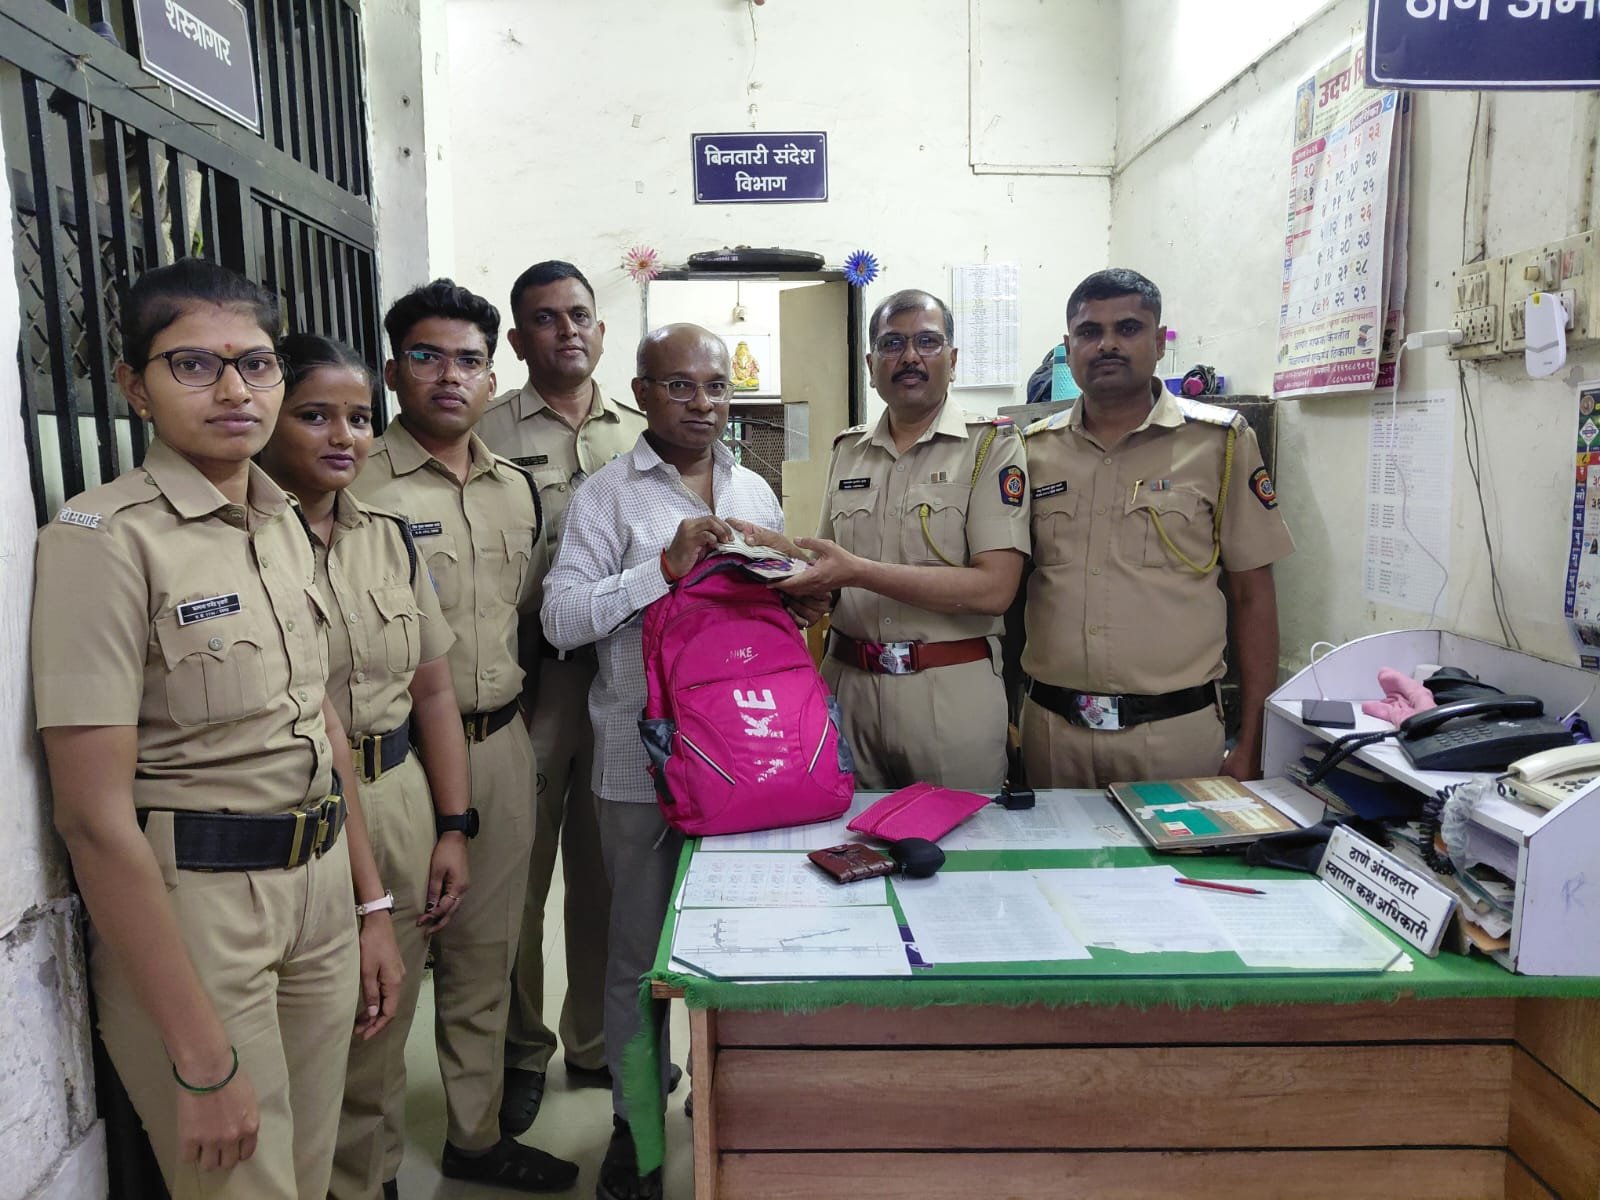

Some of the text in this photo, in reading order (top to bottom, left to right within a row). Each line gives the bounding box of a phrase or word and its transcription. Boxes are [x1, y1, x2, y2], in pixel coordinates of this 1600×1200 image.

[165, 0, 231, 66] शस्त्रागार
[704, 143, 816, 166] बिनतारी संदेश
[735, 171, 787, 192] विभाग
[1349, 846, 1419, 900] ठाणे अंमलदार
[1325, 860, 1428, 942] स्वागत कक्ष अधिकारी
